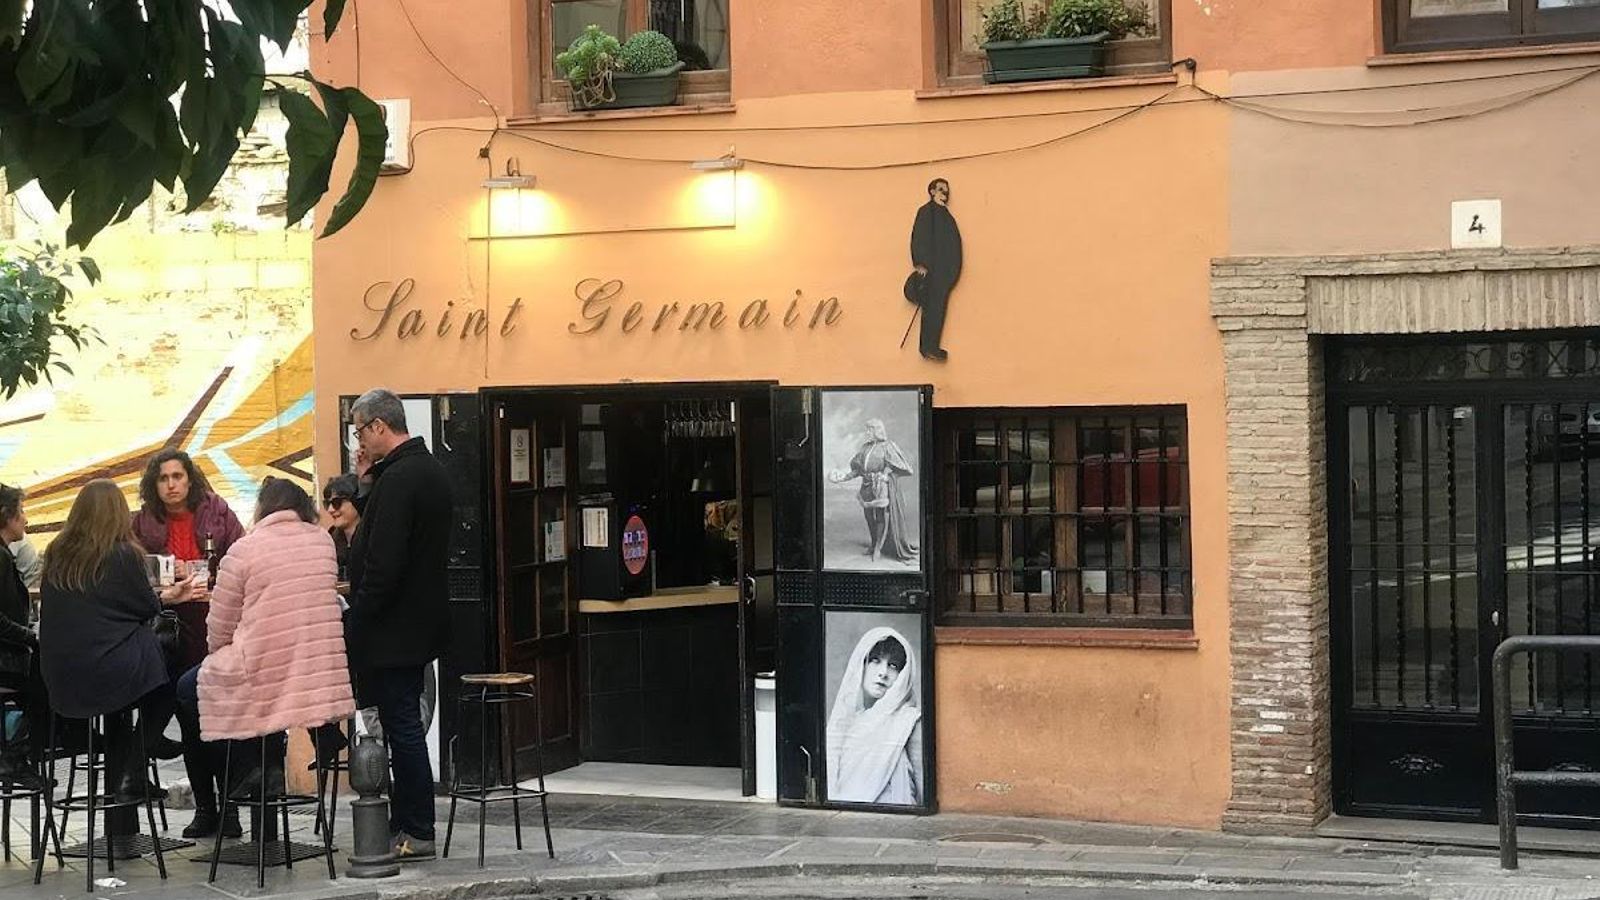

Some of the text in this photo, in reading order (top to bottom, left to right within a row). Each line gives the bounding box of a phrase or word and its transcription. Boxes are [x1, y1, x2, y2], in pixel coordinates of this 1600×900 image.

[1469, 214, 1486, 234] 4
[350, 278, 845, 340] Saint Germain
